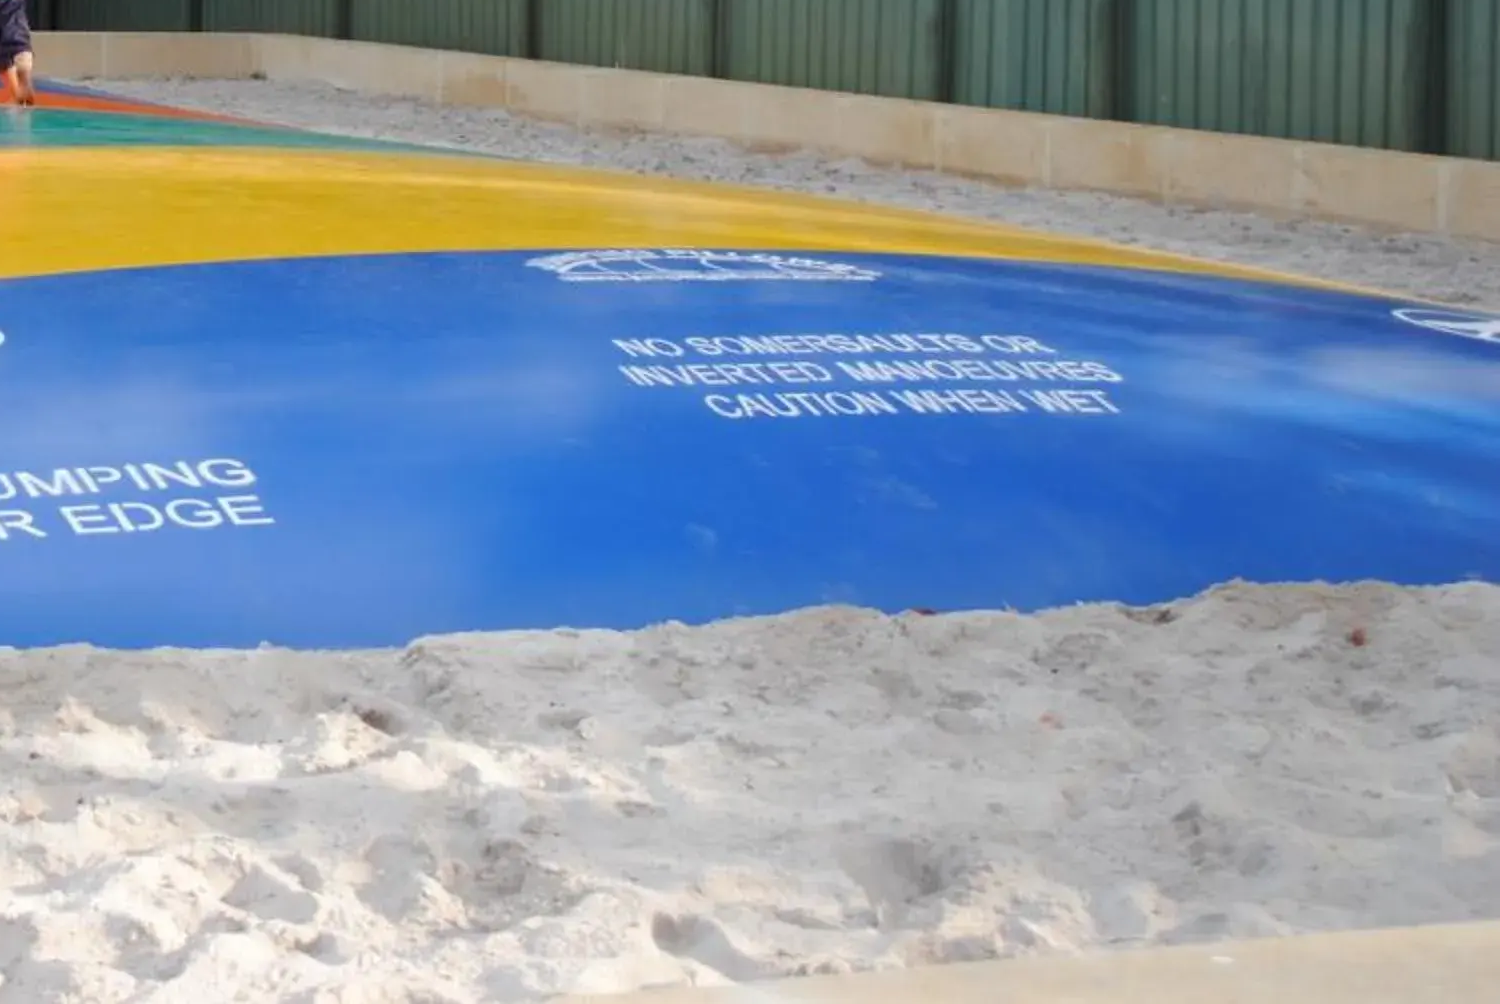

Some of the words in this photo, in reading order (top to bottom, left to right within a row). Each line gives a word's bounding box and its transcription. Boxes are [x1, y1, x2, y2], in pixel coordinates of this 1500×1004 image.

[611, 337, 685, 358] NO
[687, 334, 984, 356] SOMERSAULTS
[982, 334, 1056, 354] OR
[617, 362, 833, 387] INVERTED
[835, 360, 1124, 383] MANOEUVRES
[703, 392, 899, 419] CAUTION
[894, 390, 1027, 414] WHEN
[1020, 390, 1121, 414] WET
[60, 494, 276, 535] EDGE
